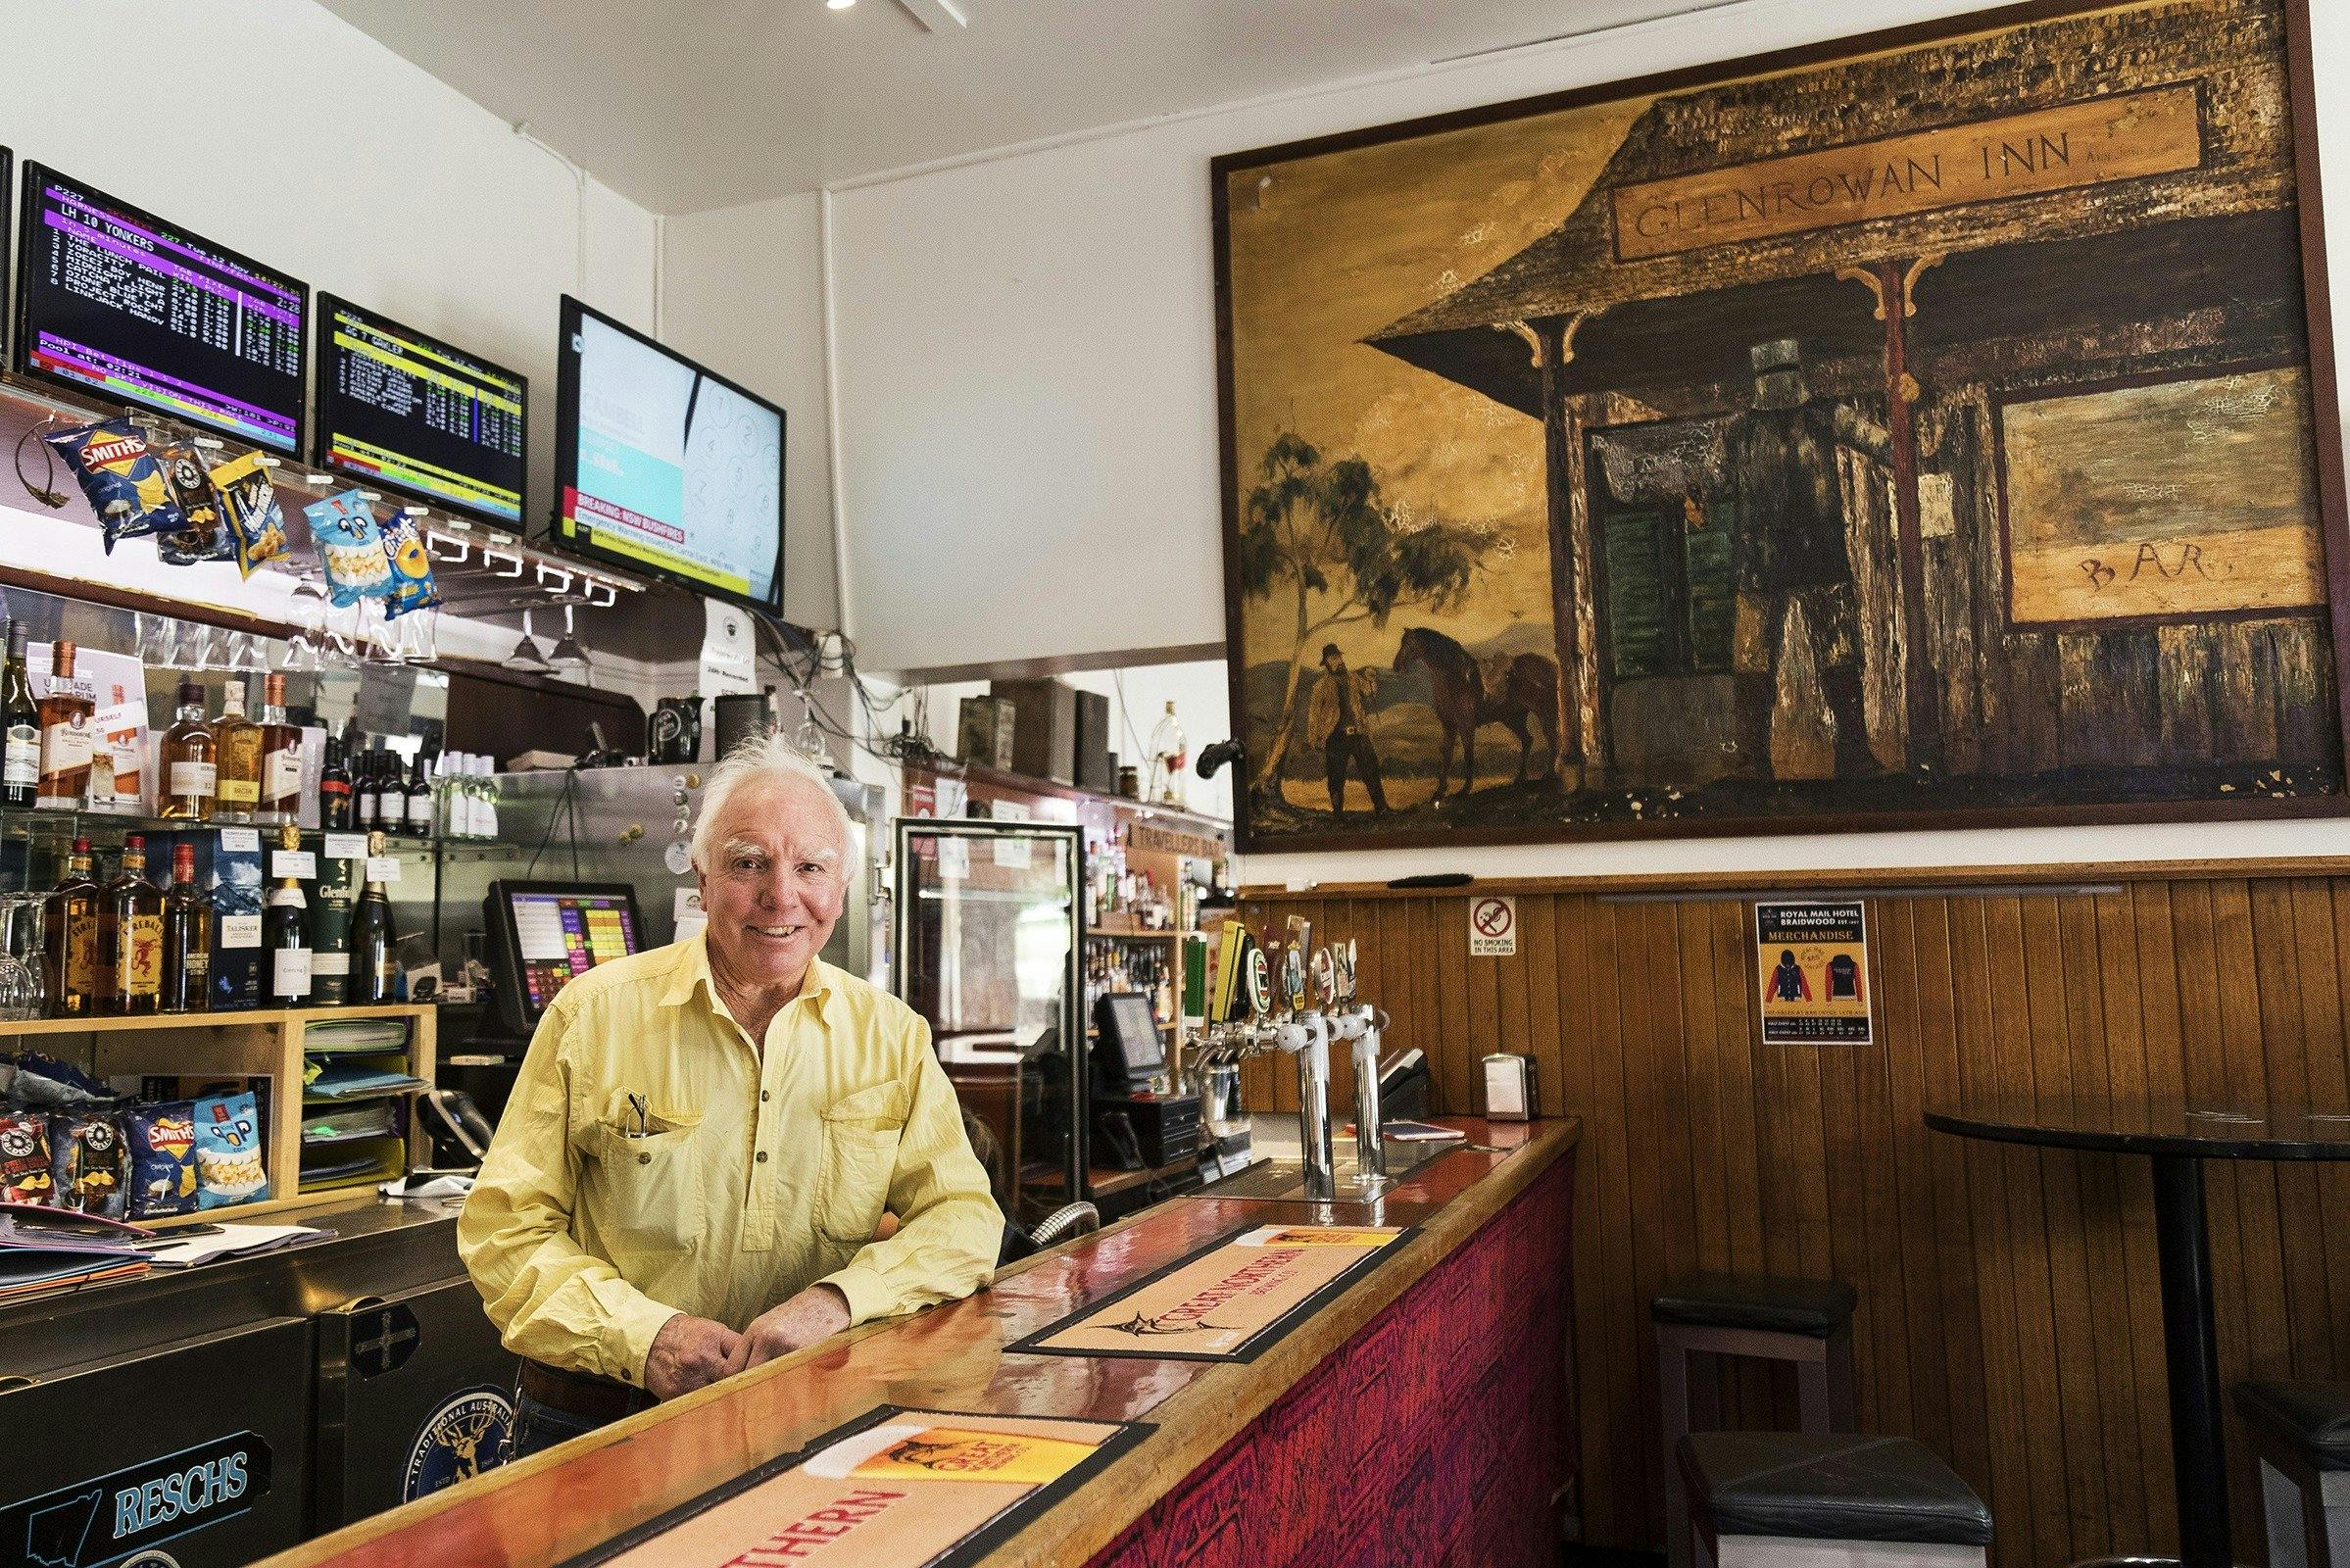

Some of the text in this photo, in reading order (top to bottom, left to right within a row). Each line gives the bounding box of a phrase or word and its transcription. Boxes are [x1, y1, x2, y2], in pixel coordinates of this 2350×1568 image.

[61, 195, 113, 222] HARNESS
[1635, 129, 2073, 242] GLENROWAN INN
[54, 184, 83, 203] P227
[161, 230, 179, 244] 227
[186, 242, 206, 256] Tue
[212, 254, 224, 265] 12
[61, 203, 76, 220] LH
[83, 212, 98, 228] 10
[104, 221, 154, 253] YONKERS
[67, 225, 97, 243] NAME
[51, 248, 59, 258] 4
[66, 255, 123, 283] MIDNIGHT
[130, 280, 165, 299] LIGHT
[52, 227, 60, 236] 1
[67, 233, 88, 248] THE
[96, 245, 131, 266] LUNCH
[138, 263, 166, 279] PAIL
[52, 234, 60, 243] 2
[67, 240, 123, 269] VORACITY
[171, 282, 198, 299] 23.0
[50, 270, 58, 278] 7
[65, 275, 116, 301] PROJECT
[122, 298, 150, 314] ROCK
[50, 276, 58, 286] 8
[65, 282, 122, 311] LINKJACK
[129, 307, 163, 326] HANOV
[51, 256, 59, 265] 5
[66, 262, 109, 284] CATCHA
[117, 281, 151, 301] LEFTY
[51, 263, 58, 271] 6
[66, 269, 101, 288] OZONE
[109, 285, 136, 302] BLUE
[144, 299, 164, 313] CHI
[171, 310, 197, 325] 14.0
[52, 241, 59, 251] 3
[67, 247, 102, 268] ZOEEZ
[110, 265, 130, 279] BOY
[137, 276, 165, 293] HENR
[171, 289, 198, 306] 4.40
[203, 303, 229, 318] 1.45
[39, 338, 70, 355] Pool
[76, 352, 97, 364] at:
[106, 362, 140, 378] 02:21
[91, 364, 107, 374] NO
[114, 371, 133, 383] SKY
[142, 381, 181, 400] VISION
[2081, 542, 2208, 591] BAR
[123, 919, 165, 936] FREBALL
[1768, 930, 1853, 941] MERCHANDISE
[1780, 910, 1809, 919] ROYAL
[1810, 909, 1832, 918] MAIL
[1781, 917, 1836, 926] BRAIDWOOD
[1151, 1249, 1310, 1321] GREAT NORTHERN
[112, 1450, 249, 1540] RESCHS
